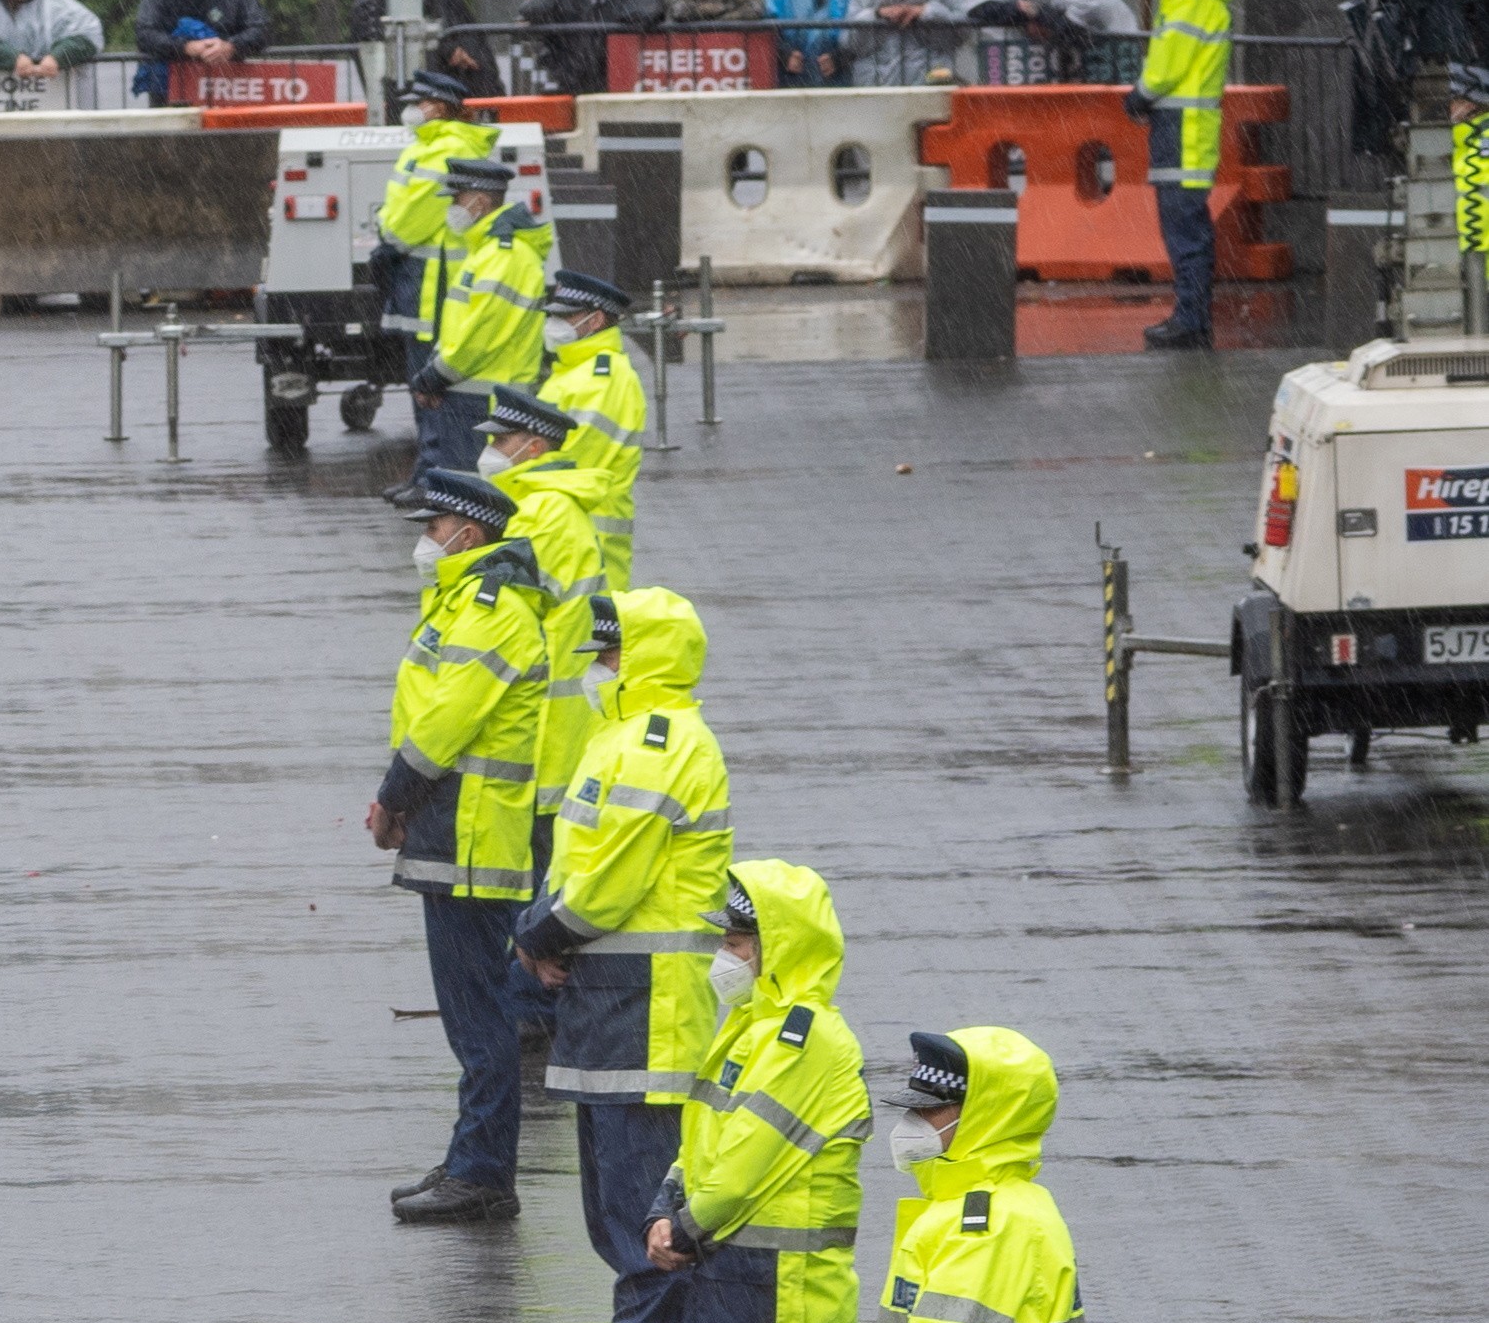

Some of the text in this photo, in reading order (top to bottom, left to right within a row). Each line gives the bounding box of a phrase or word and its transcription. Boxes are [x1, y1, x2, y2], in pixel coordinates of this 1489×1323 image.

[639, 47, 747, 73] FREE TO
[198, 76, 308, 102] FREE TO
[1449, 515, 1474, 536] 15
